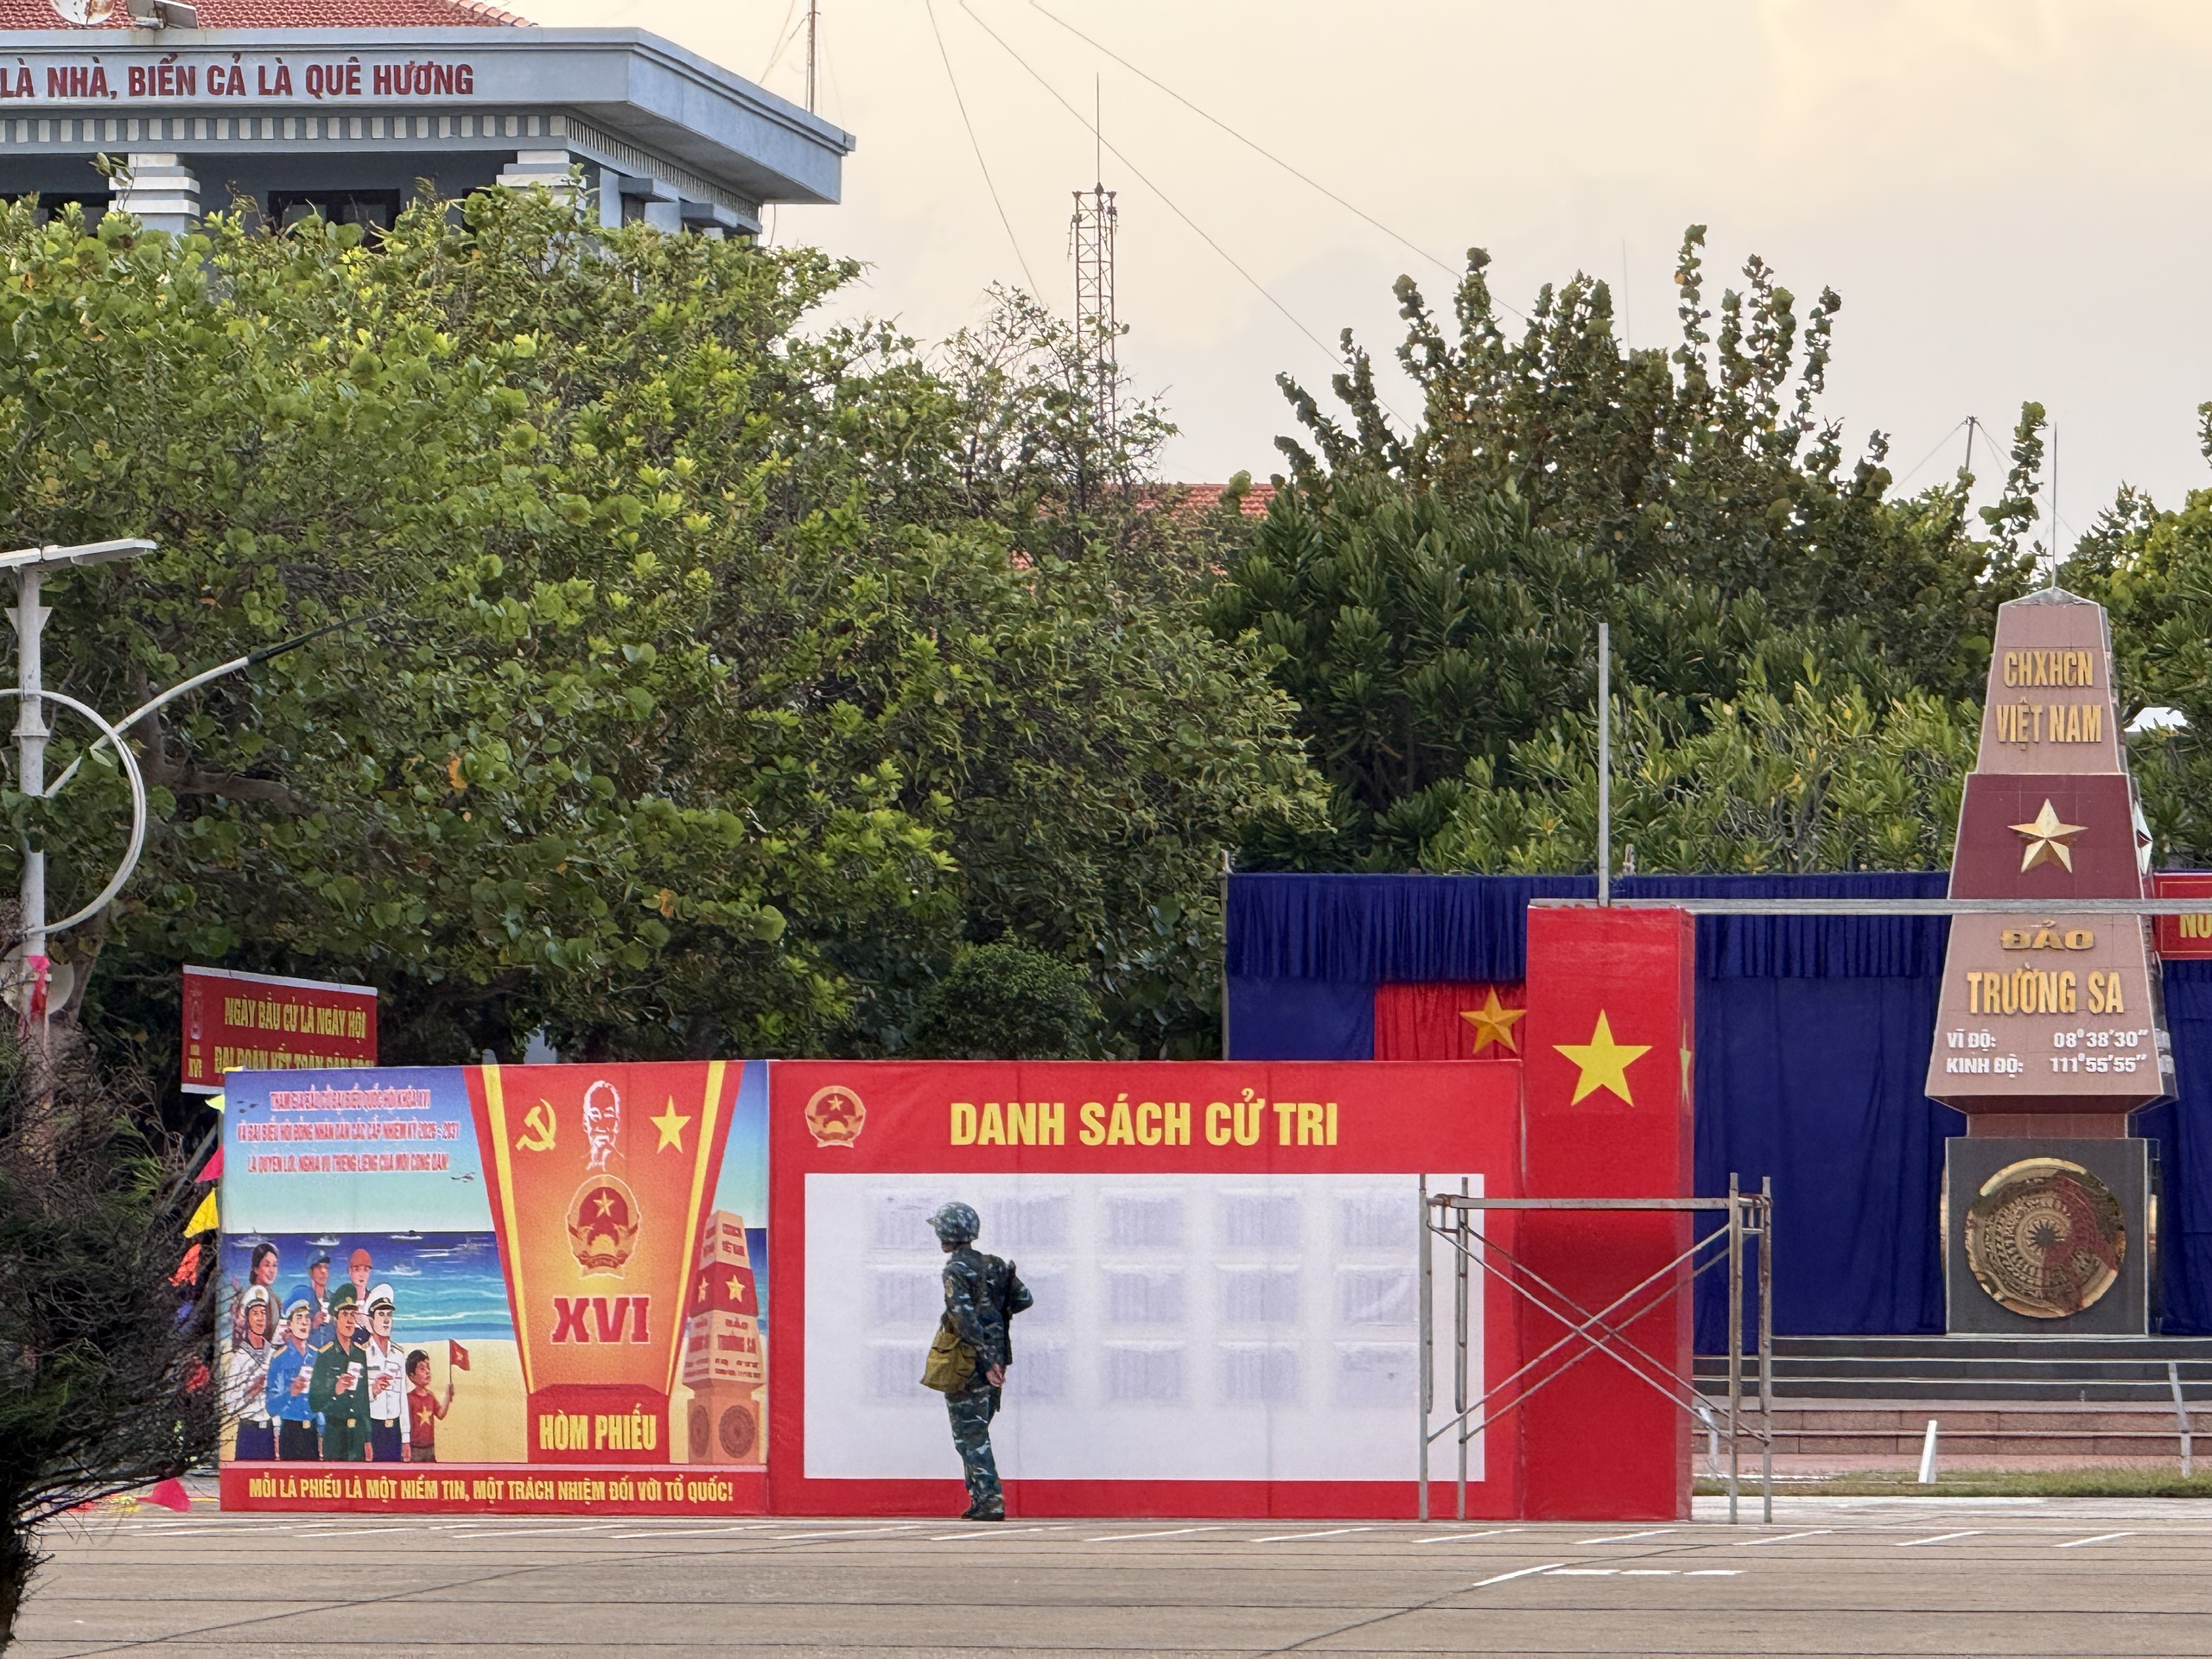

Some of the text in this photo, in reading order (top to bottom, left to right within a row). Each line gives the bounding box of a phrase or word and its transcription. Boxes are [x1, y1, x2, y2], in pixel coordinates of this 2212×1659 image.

[0, 52, 474, 99] LÀ NHÀ, BIỂN CẢ LÀ QUÊ HƯƠNG
[2004, 651, 2094, 688] CHXHCN
[1996, 696, 2102, 751] VIỆT NAM
[2000, 918, 2094, 950] ĐẢO
[1967, 962, 2125, 1014] TRƯỜNG SA
[225, 994, 256, 1028] NGÀY
[300, 1001, 315, 1033] LÀ
[950, 1088, 1338, 1146] DANH SÁCH CỬ TRI
[550, 1295, 651, 1344] XVI
[539, 1402, 657, 1450] HÒM PHIẾU
[300, 1472, 341, 1498] PHIẾU
[345, 1475, 363, 1498] LÀ
[365, 1475, 397, 1503] MỘT
[473, 1476, 504, 1504] MỘT
[507, 1476, 554, 1500] TRÁCH
[557, 1478, 606, 1505] NHIỆM
[609, 1475, 634, 1501] ĐỐI
[688, 1475, 734, 1503] QUỐC!
